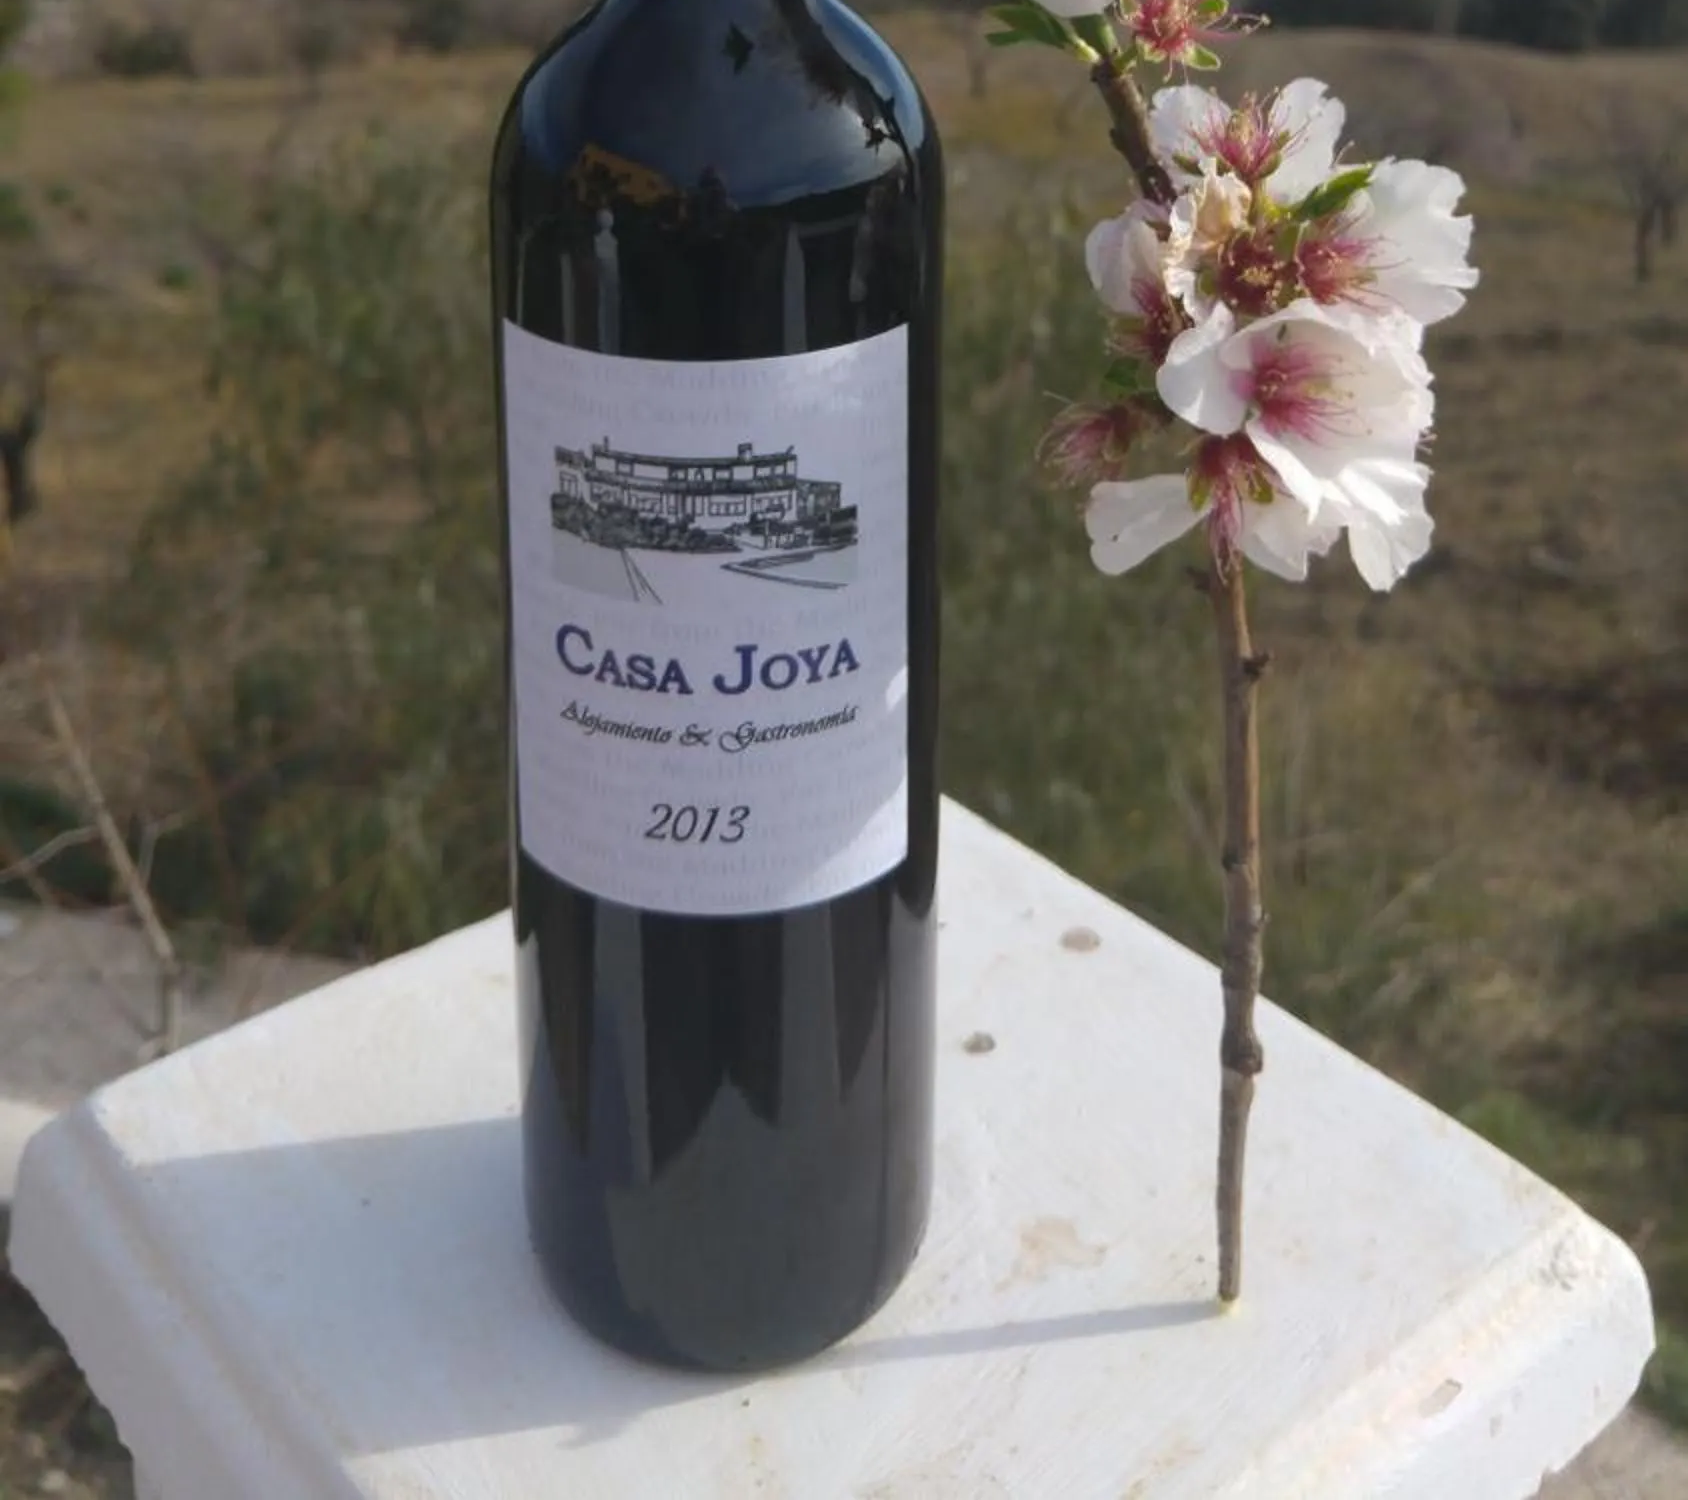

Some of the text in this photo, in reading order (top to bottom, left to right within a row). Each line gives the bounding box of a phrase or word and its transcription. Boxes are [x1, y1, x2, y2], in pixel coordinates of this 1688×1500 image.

[555, 623, 861, 695] CASA JOYA
[680, 723, 712, 747] &
[645, 803, 751, 843] 2013
